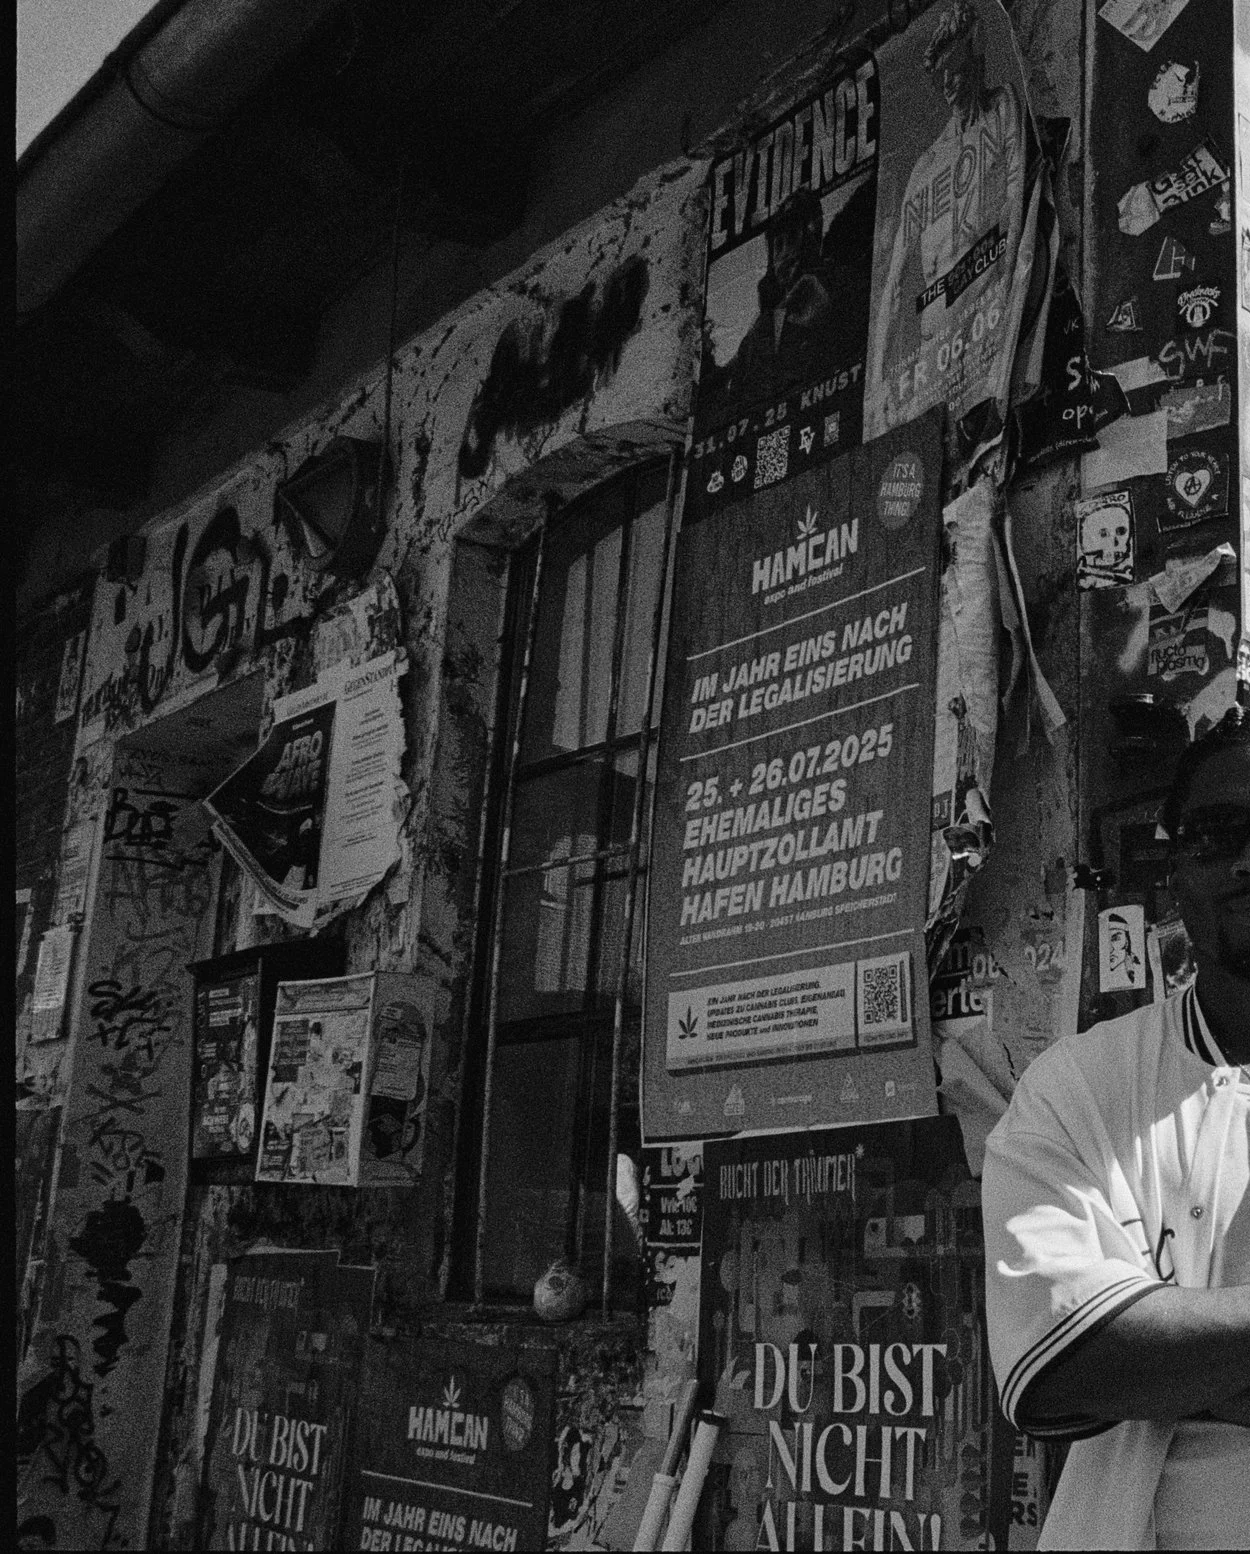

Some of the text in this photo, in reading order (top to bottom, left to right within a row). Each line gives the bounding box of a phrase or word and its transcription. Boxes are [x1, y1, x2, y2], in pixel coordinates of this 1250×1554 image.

[711, 60, 876, 250] EVIDENCE
[922, 277, 945, 306] THE
[975, 238, 1007, 275] CLUB
[880, 482, 921, 498] HAMBURG
[752, 517, 859, 595] HAMCAN
[787, 578, 807, 595] and
[689, 634, 913, 735] DER LEGALISIERUNG
[691, 602, 908, 704] IM JAHR EINS NACH
[274, 730, 323, 774] AFRO
[685, 775, 723, 813] 25.
[749, 722, 894, 796] 26.07.2025
[681, 809, 884, 888] HAUPTZOLLAMT
[683, 778, 847, 851] EHEMALIGES
[679, 847, 902, 927] HAFEN HAMBURG
[746, 1000, 777, 1012] CANNABIS
[753, 1012, 785, 1023] CANNABIS
[756, 990, 769, 999] DER
[719, 1164, 758, 1201] BUCHT
[762, 1160, 790, 1206] DER
[754, 1342, 949, 1418] DU BIST
[231, 1406, 328, 1477] DU BIST
[407, 1405, 489, 1450] HAMCAN
[764, 1420, 927, 1501] NICHT
[237, 1463, 314, 1533] NICHT
[362, 1496, 383, 1523] IM
[383, 1502, 427, 1532] JAHR
[427, 1510, 467, 1543] EINS
[468, 1519, 518, 1551] NACH
[360, 1526, 394, 1551] DER
